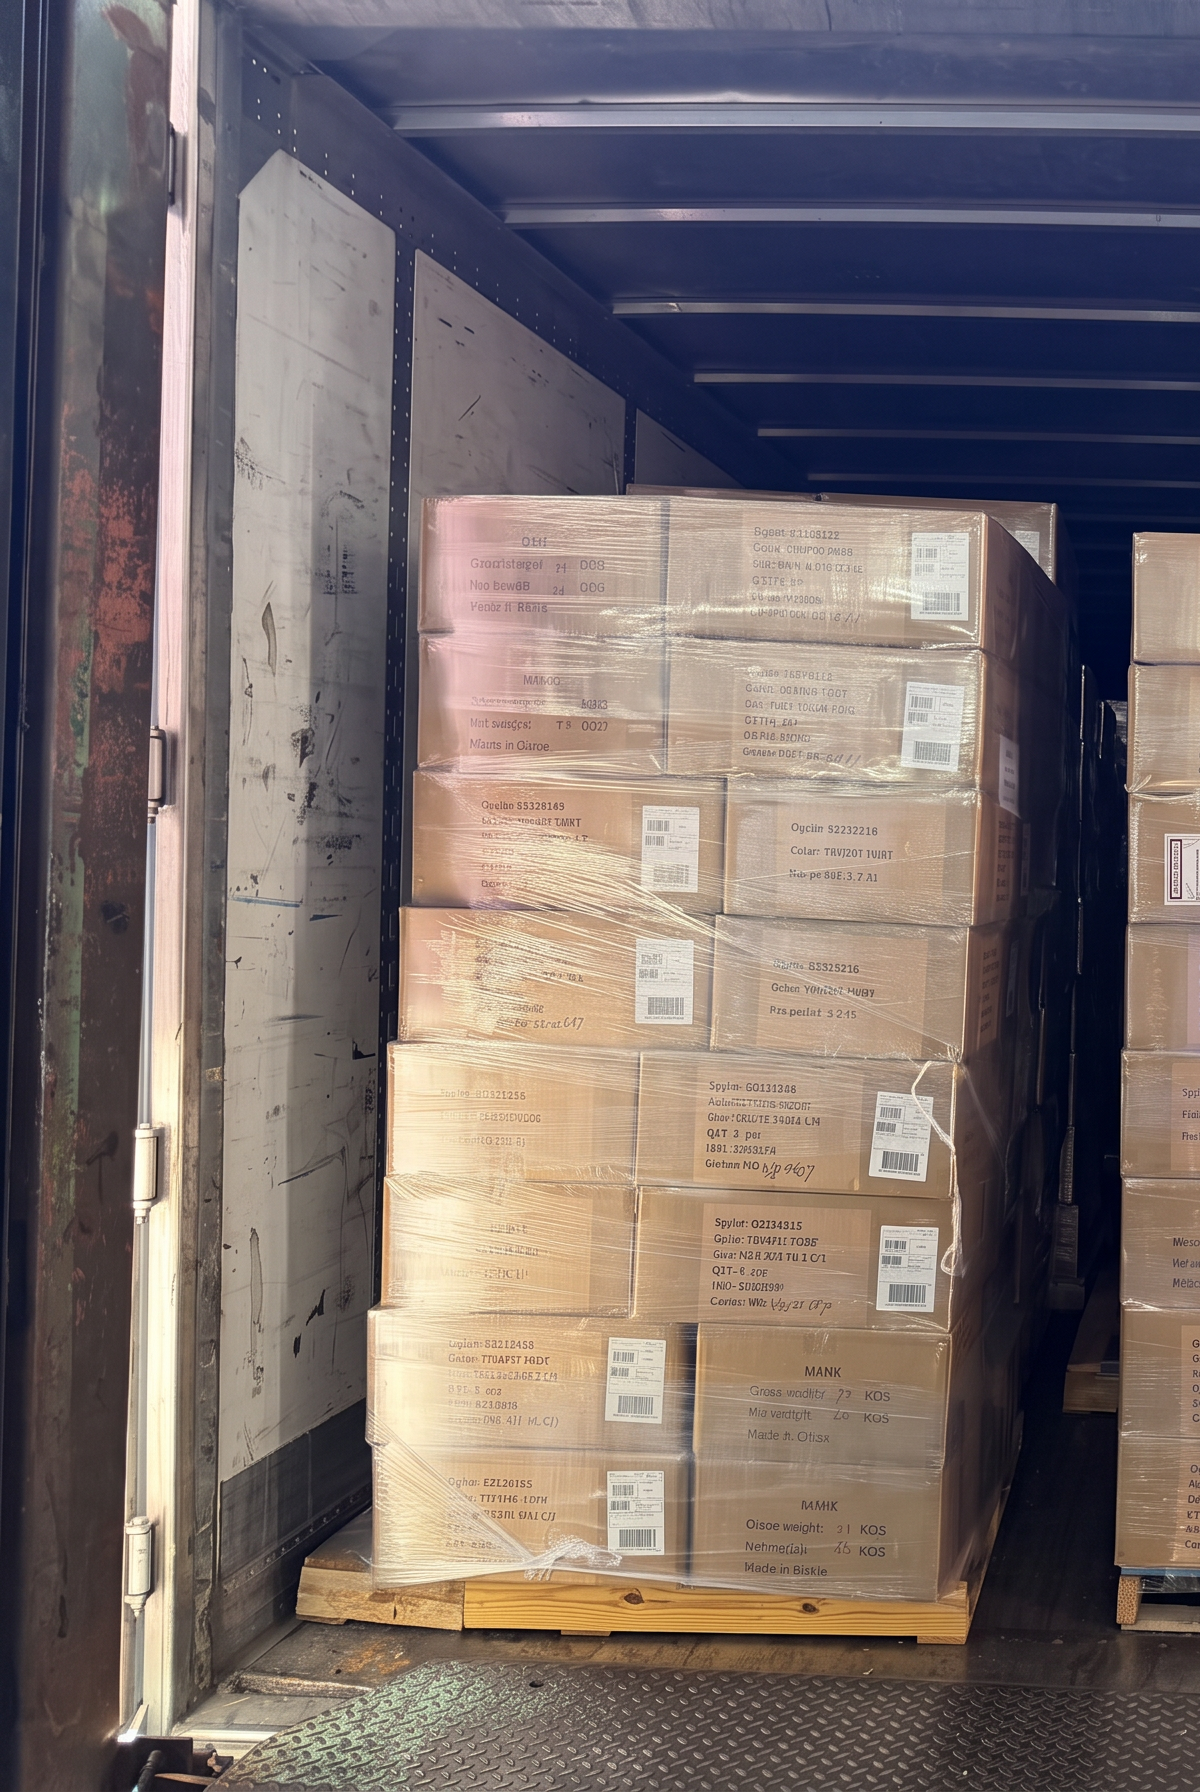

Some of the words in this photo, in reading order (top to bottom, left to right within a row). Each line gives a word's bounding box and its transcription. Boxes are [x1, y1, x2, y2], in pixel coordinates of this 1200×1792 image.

[804, 1366, 842, 1378] MANK
[865, 1390, 890, 1402] KOS
[864, 1413, 889, 1423] KOS
[860, 1524, 886, 1536] KOS
[860, 1546, 886, 1557] KOS
[744, 1562, 776, 1573] Made
[780, 1563, 790, 1574] in
